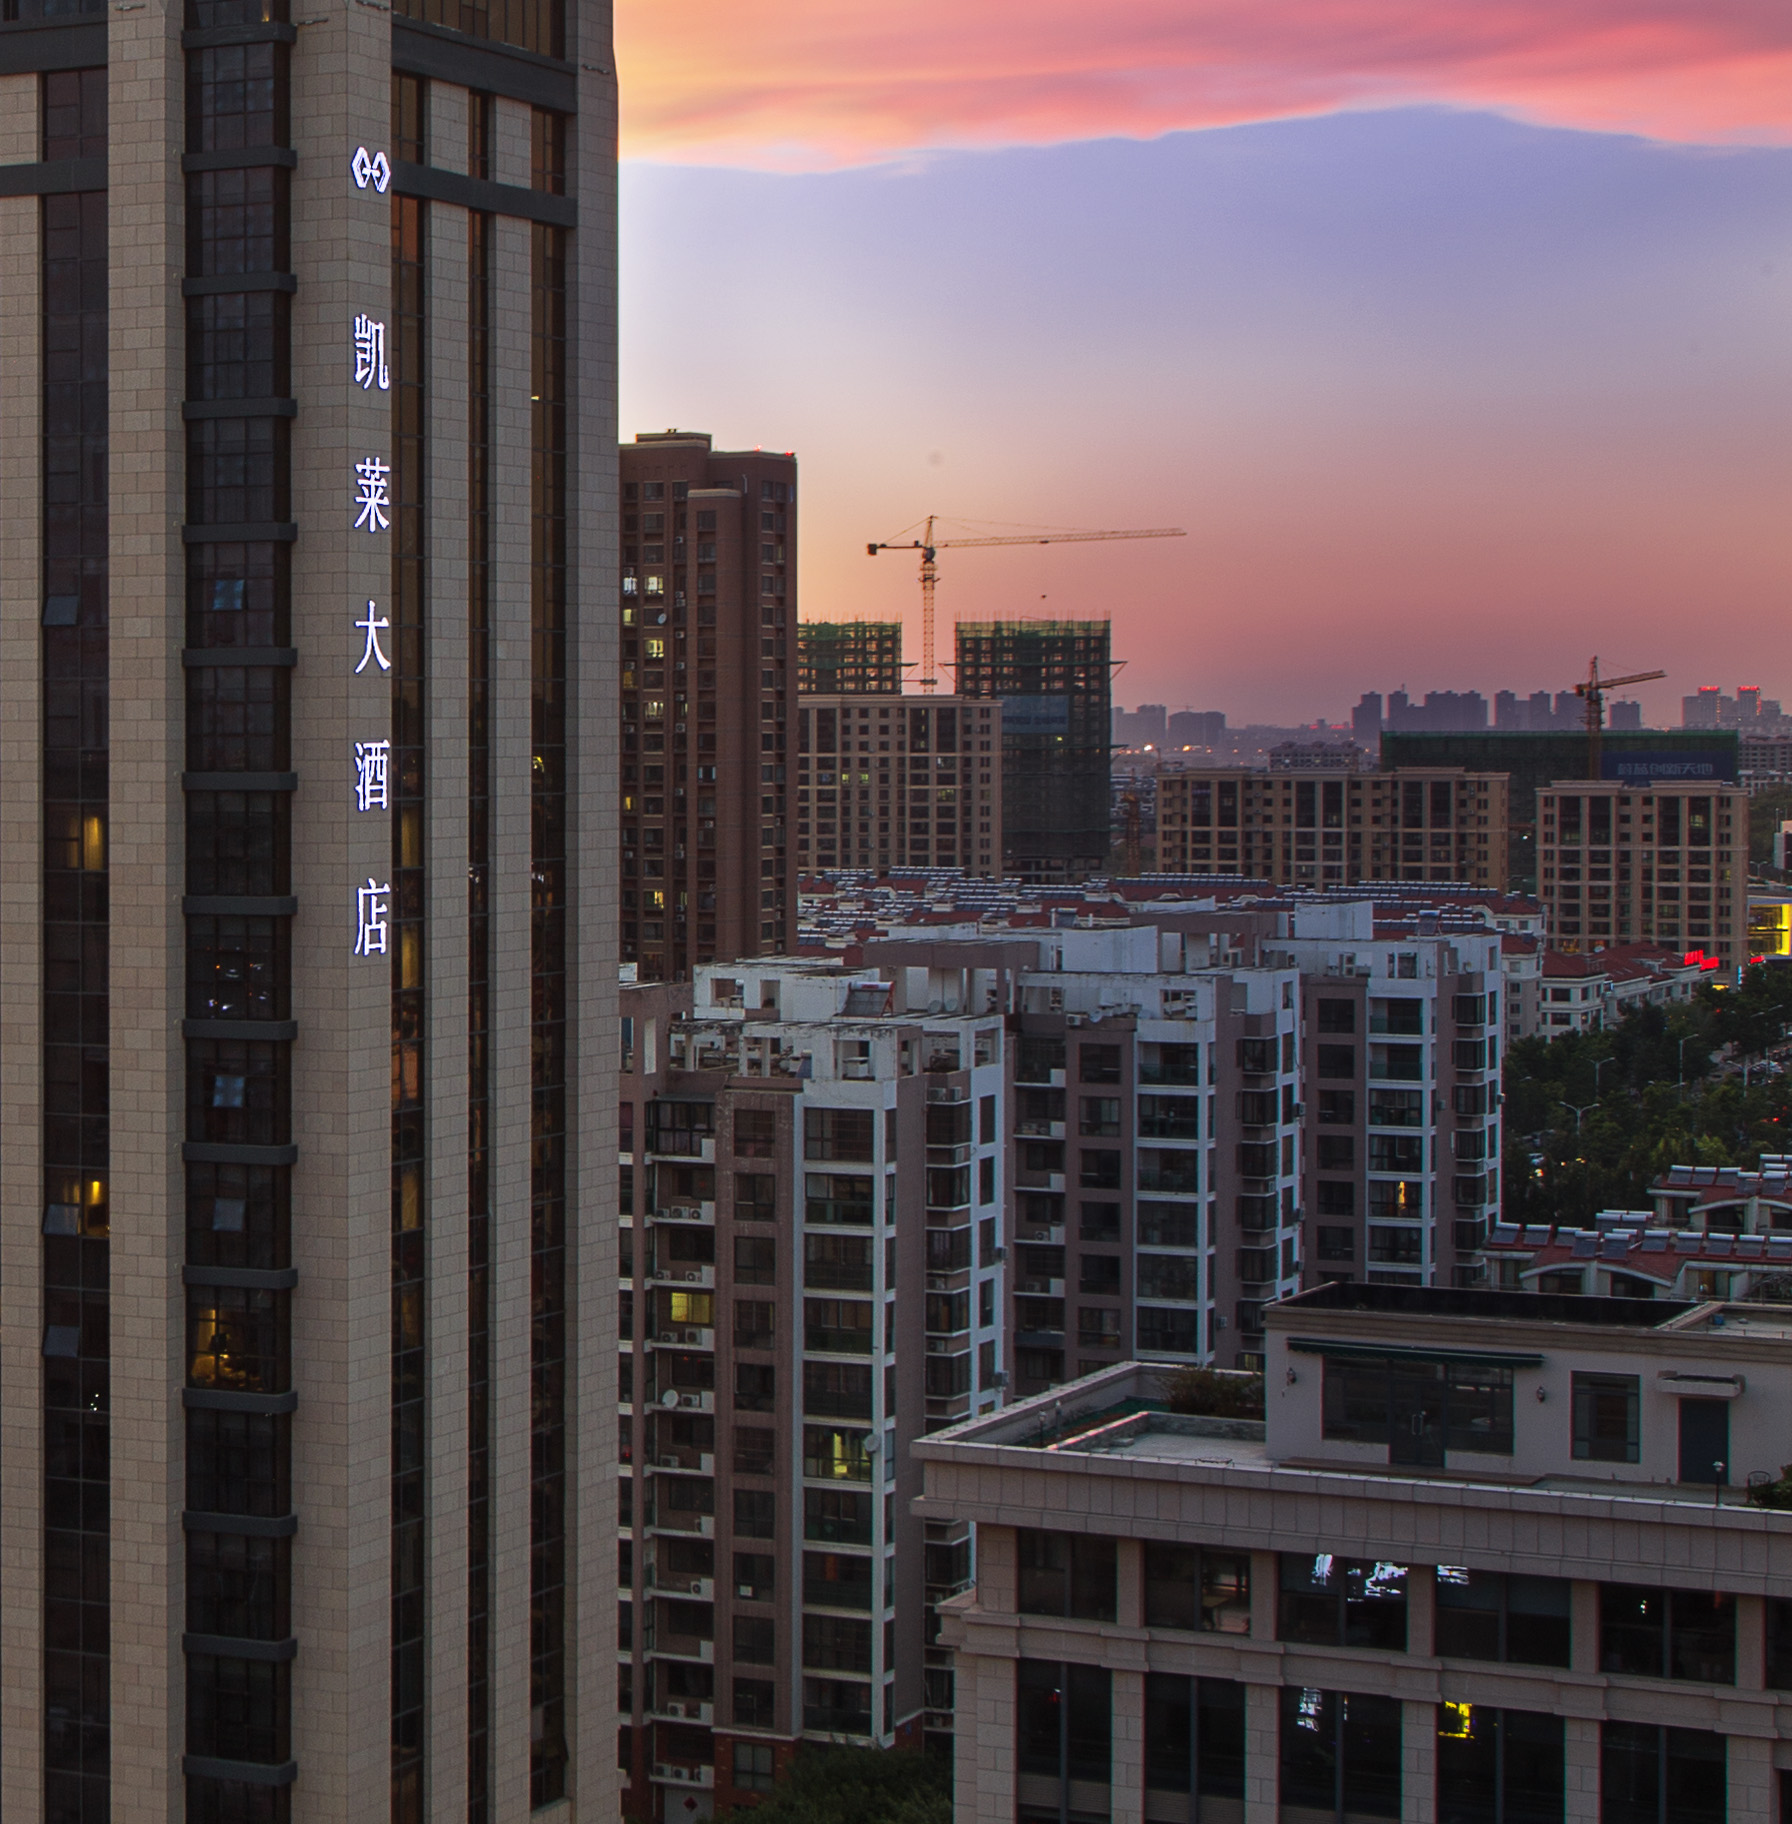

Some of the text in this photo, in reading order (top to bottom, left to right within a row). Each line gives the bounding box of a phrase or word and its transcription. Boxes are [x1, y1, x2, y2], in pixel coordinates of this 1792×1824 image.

[354, 313, 391, 956] 凯莱大酒店
